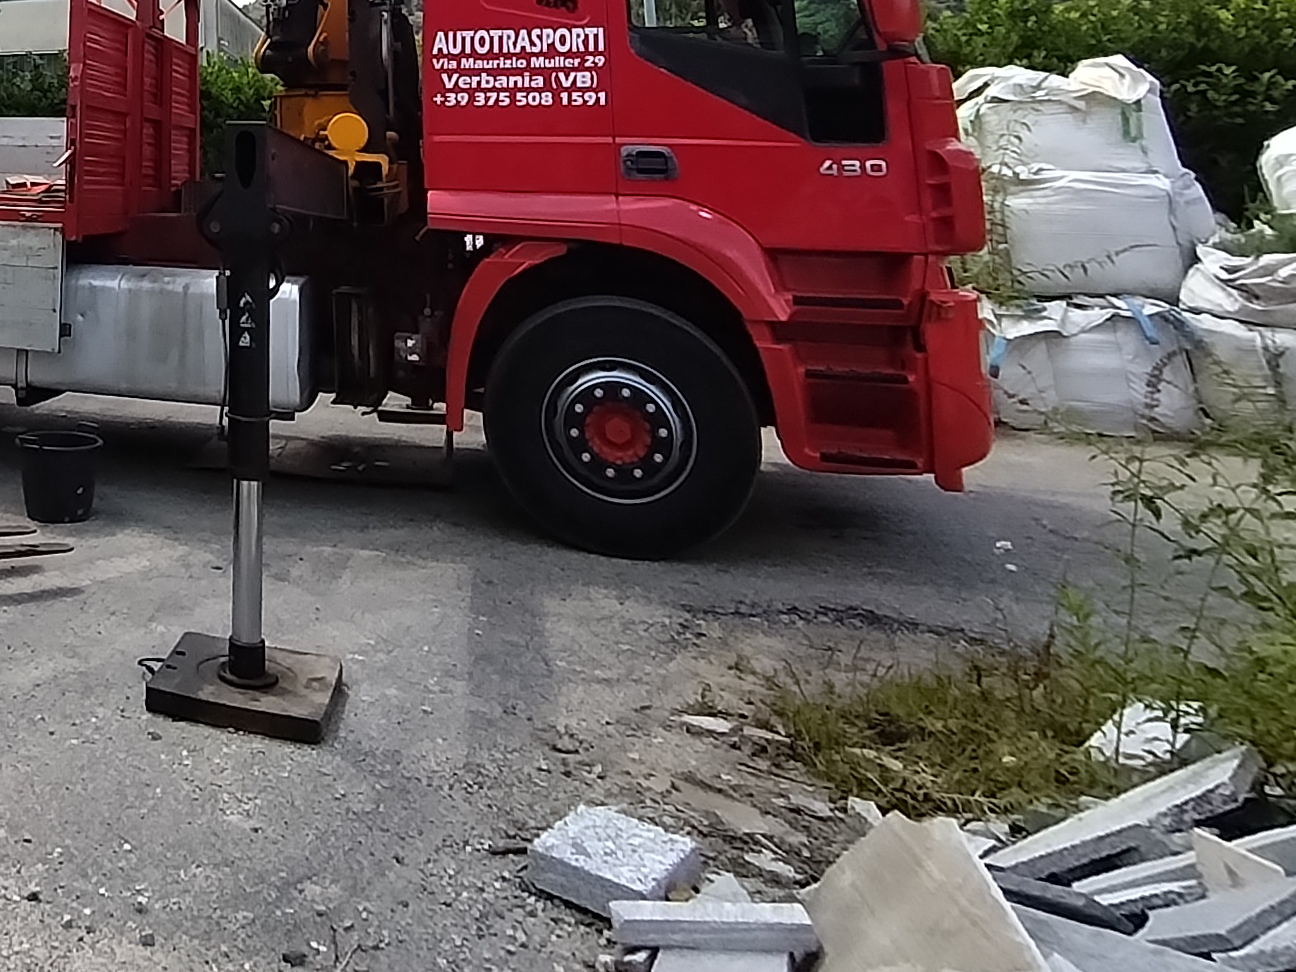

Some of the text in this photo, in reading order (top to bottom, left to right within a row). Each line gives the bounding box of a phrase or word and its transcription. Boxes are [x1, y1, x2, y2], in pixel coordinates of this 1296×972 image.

[432, 27, 605, 55] AUTOTRASPORTI
[432, 55, 605, 70] Via Maurizio Muller 29
[441, 70, 598, 89] Verbania (VB)
[432, 91, 606, 107] +39 375 508 1591
[819, 159, 888, 177] 430
